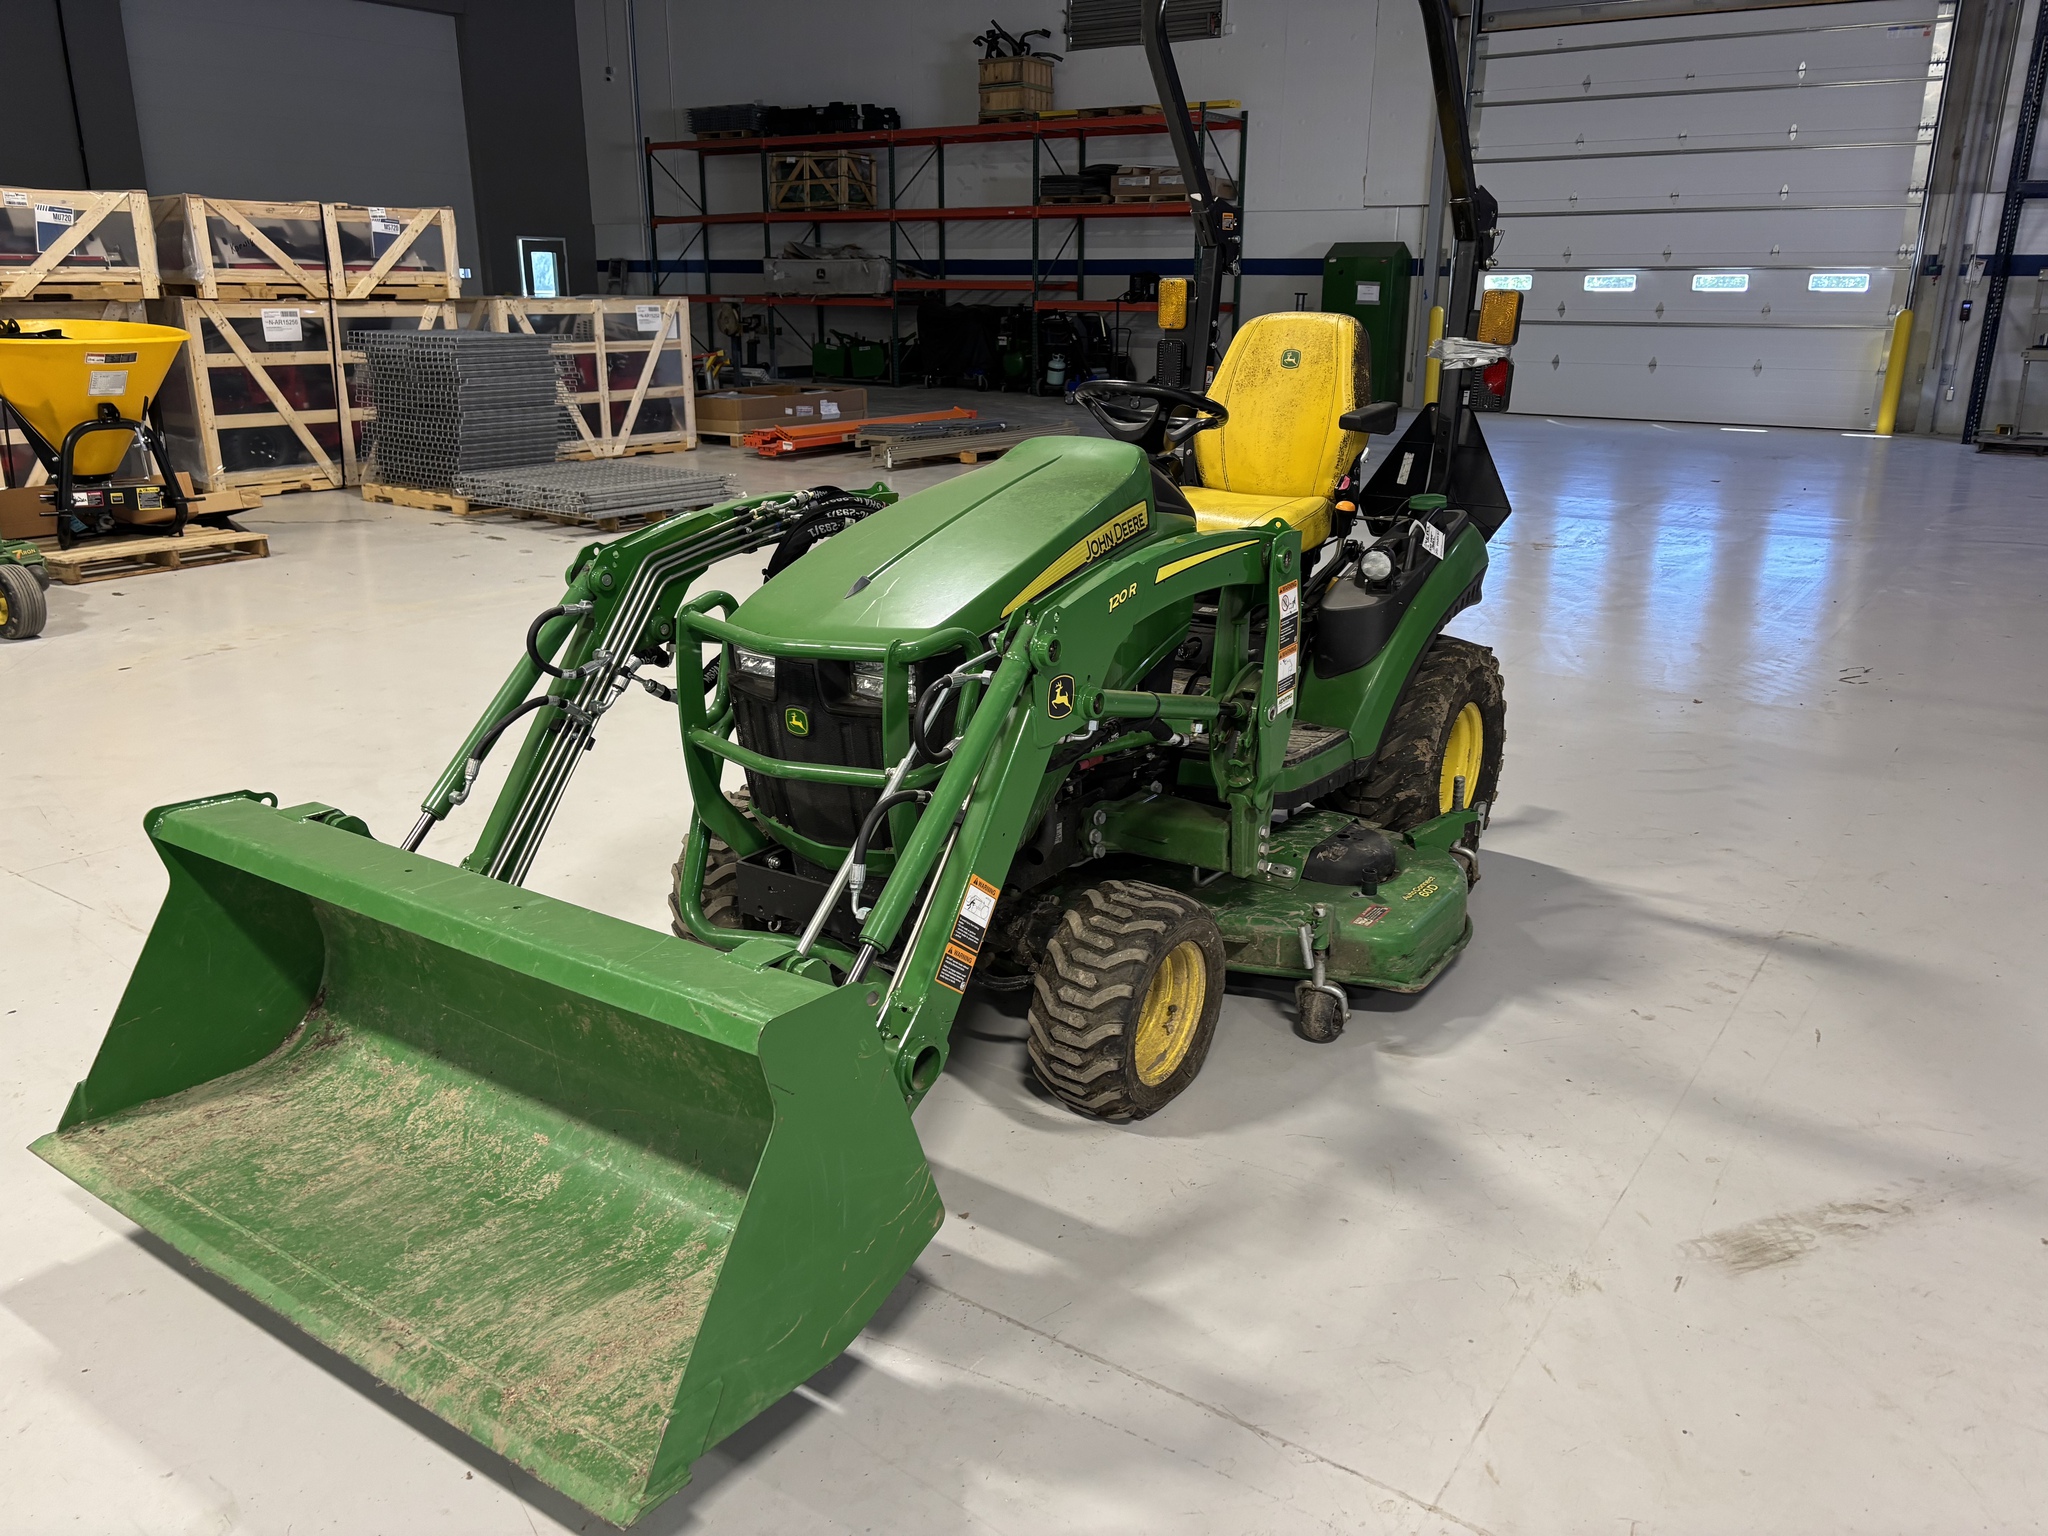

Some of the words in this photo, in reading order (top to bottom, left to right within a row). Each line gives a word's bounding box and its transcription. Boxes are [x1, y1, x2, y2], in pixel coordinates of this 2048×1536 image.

[1086, 530, 1116, 561] JOHN
[1113, 512, 1146, 543] DEERE
[977, 881, 996, 896] WARNING
[1418, 884, 1439, 898] 60D
[953, 950, 972, 964] WARNING
